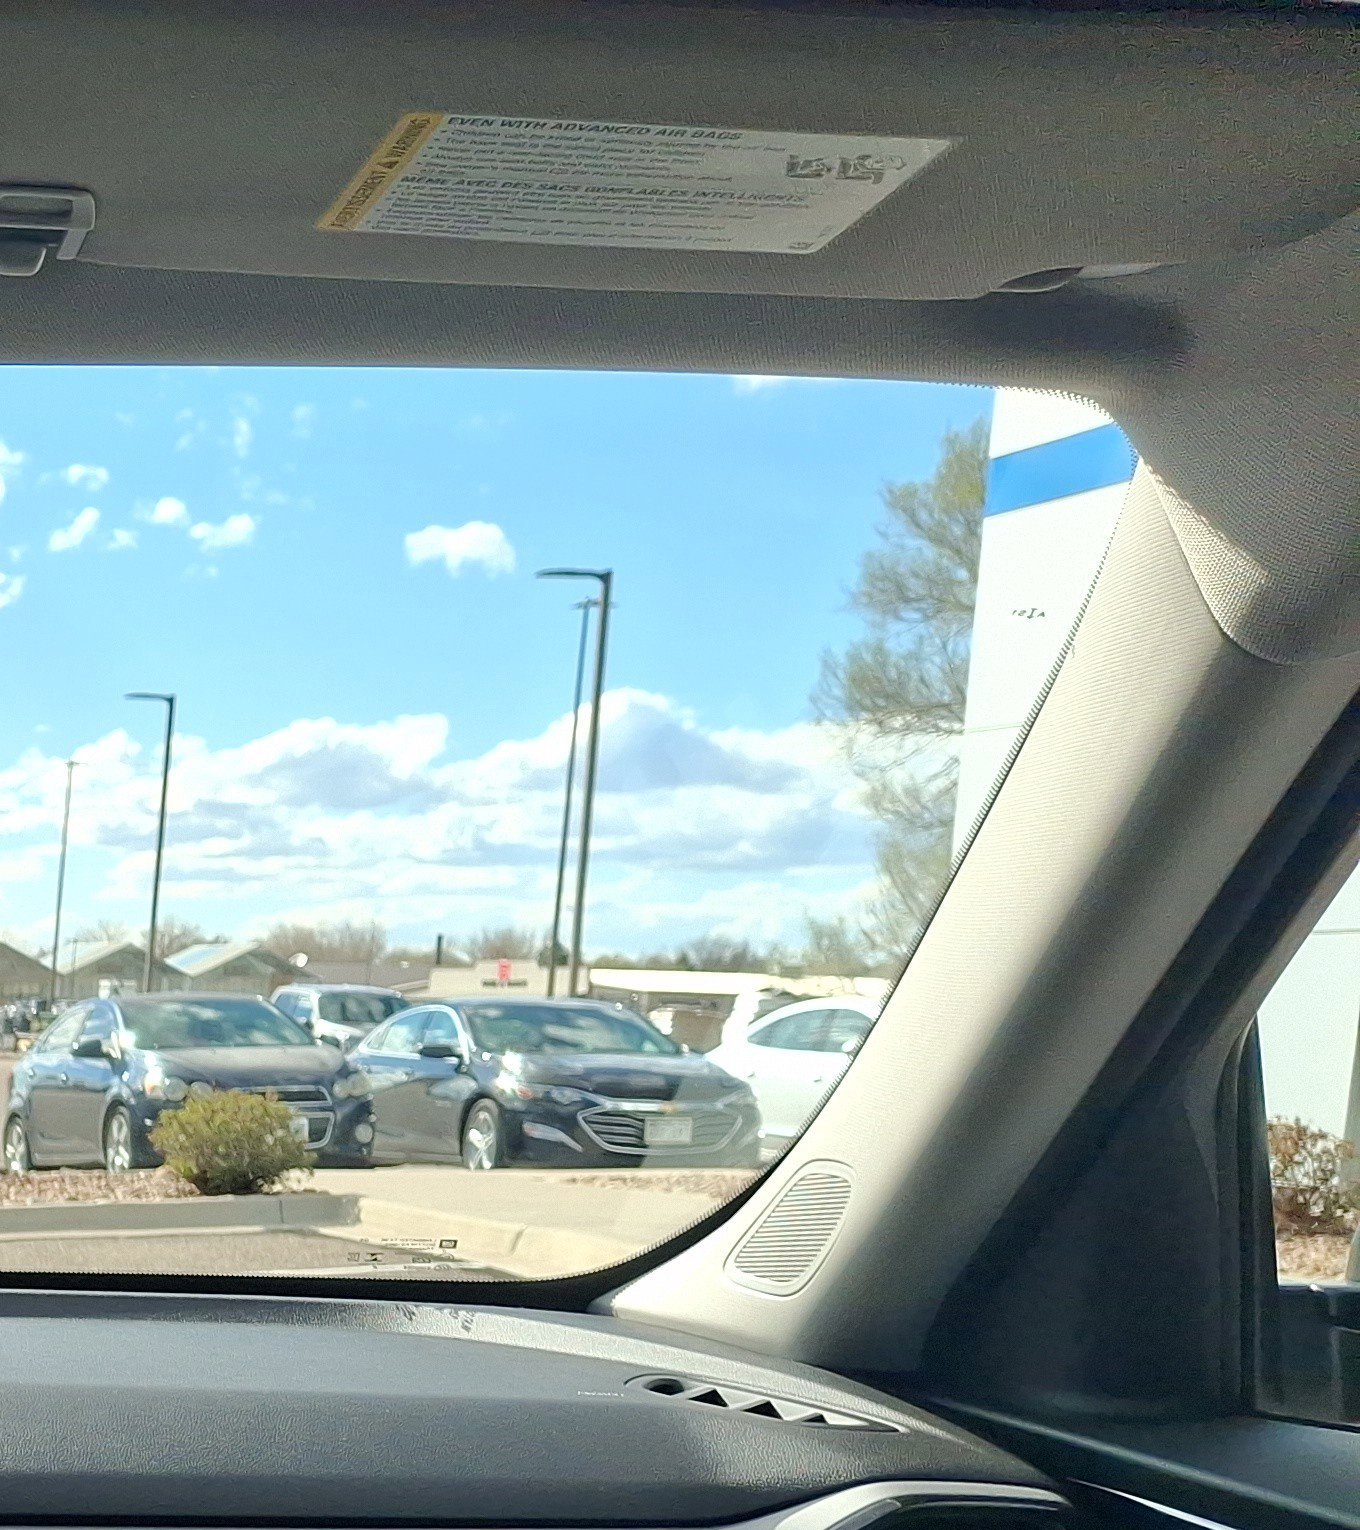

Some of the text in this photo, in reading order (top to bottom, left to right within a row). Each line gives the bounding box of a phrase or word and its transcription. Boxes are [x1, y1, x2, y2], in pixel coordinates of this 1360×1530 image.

[447, 116, 495, 127] EVEN
[500, 118, 547, 131] WITH
[550, 121, 651, 135] ADVANCED
[654, 127, 686, 138] AIR
